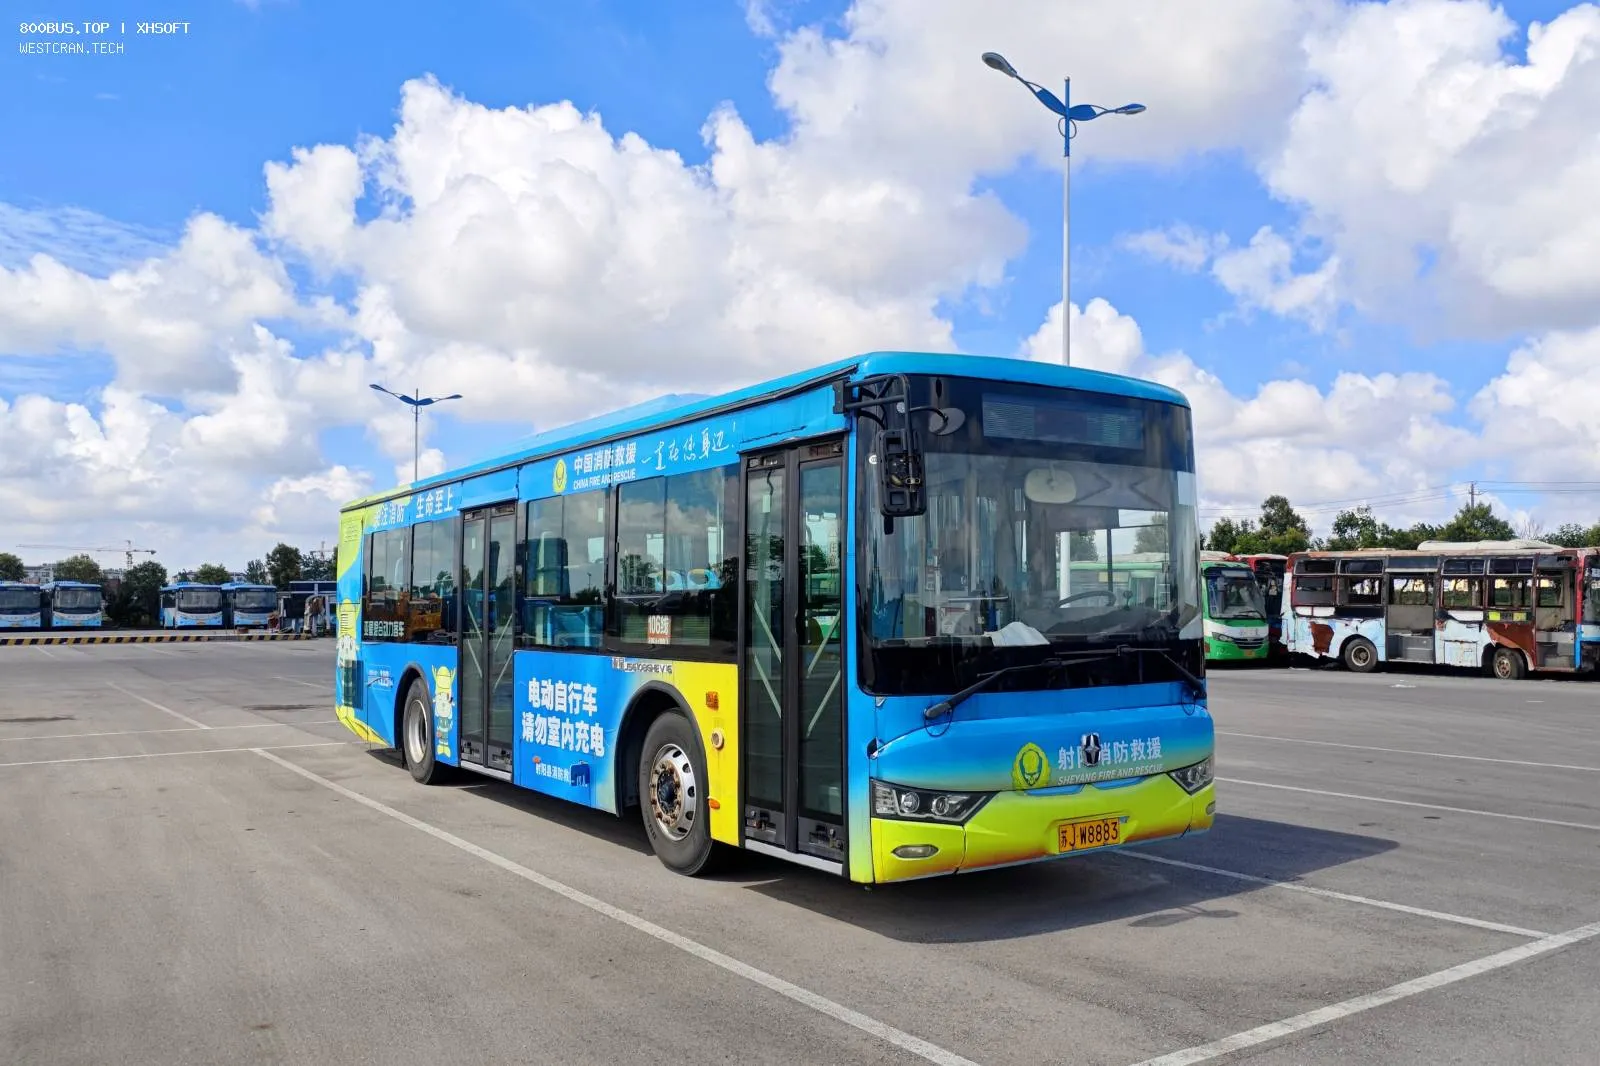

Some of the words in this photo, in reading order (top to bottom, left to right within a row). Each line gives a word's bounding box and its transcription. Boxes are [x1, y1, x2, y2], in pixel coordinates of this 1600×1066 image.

[574, 441, 637, 476] 中国消防救援
[573, 477, 589, 490] CHINA
[589, 475, 601, 486] FIRE
[614, 468, 636, 482] RESCUE
[415, 486, 454, 519] 生命至上
[528, 677, 598, 717] 电动自行车
[521, 711, 605, 757] 请勿室内充电
[1057, 771, 1097, 786] SHEYANG
[1098, 769, 1117, 780] FIRE
[1117, 767, 1134, 777] AND
[1134, 763, 1164, 775] RESCUE
